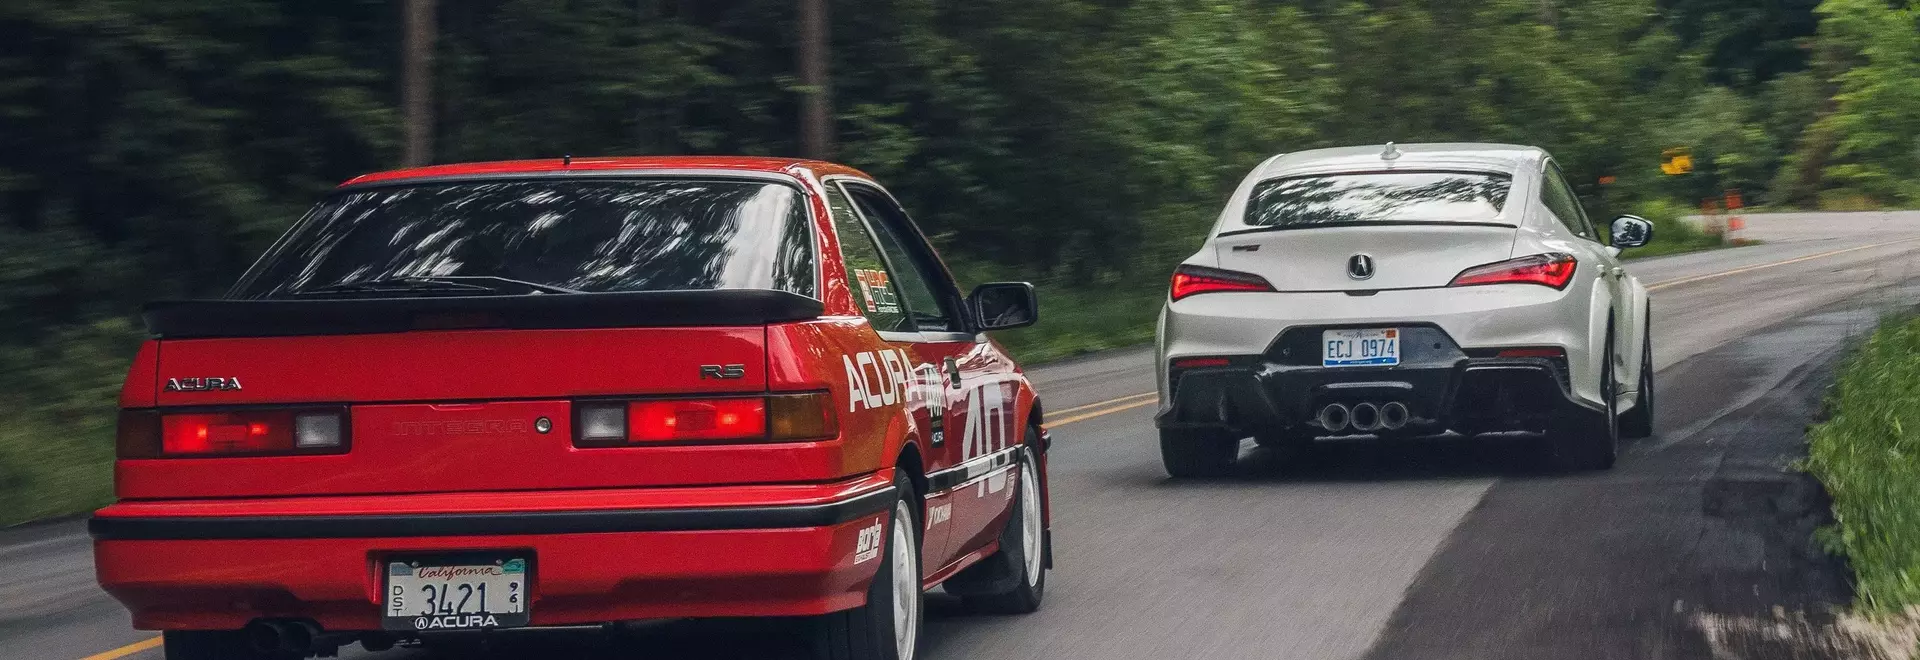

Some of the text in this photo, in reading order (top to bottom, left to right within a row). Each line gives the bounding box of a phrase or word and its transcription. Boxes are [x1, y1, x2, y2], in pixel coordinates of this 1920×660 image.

[1328, 339, 1395, 358] ECJ 0974
[700, 363, 745, 379] RS
[163, 376, 242, 393] ACURA
[842, 348, 923, 413] ACURA
[962, 379, 1007, 498] 40
[418, 566, 502, 581] California
[421, 582, 490, 616] 3421
[428, 614, 499, 629] ACURA
